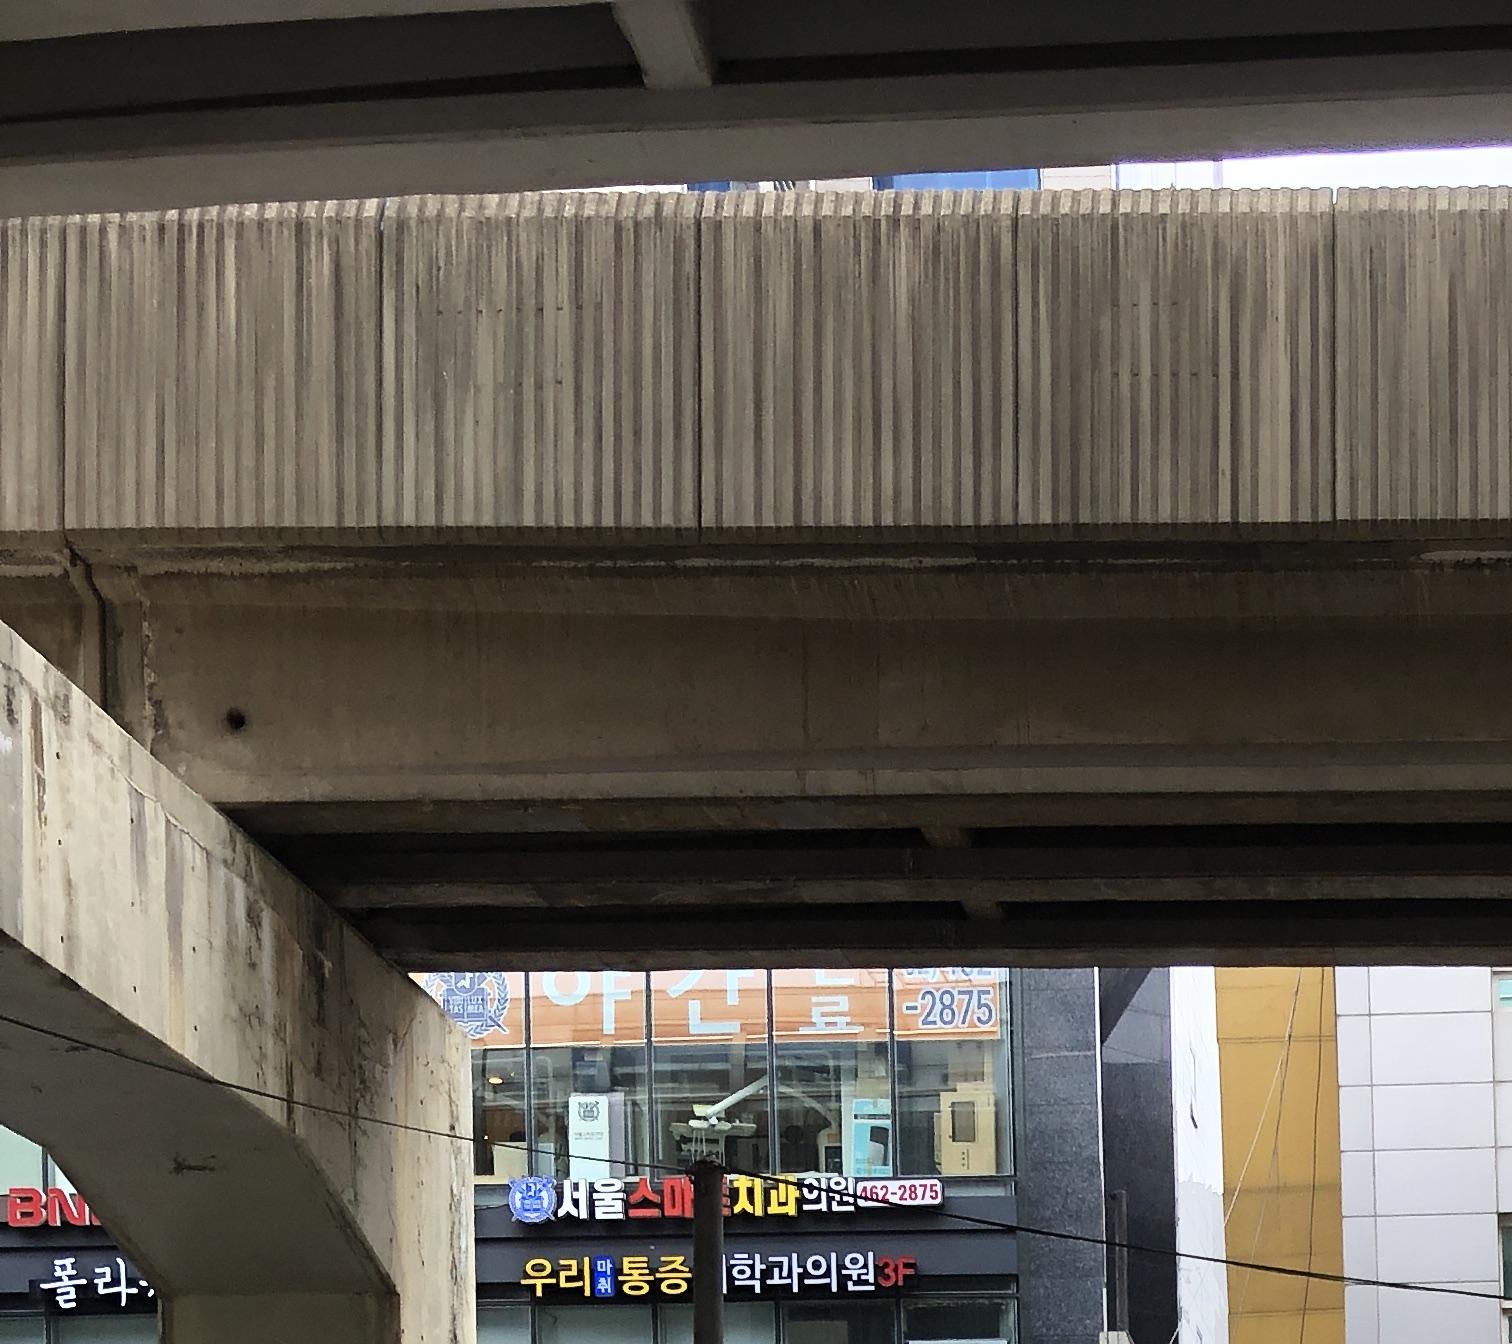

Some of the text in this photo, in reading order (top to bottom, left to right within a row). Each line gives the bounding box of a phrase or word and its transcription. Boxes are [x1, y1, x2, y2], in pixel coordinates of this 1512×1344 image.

[905, 988, 994, 1027] -2875
[8, 1187, 102, 1227] BN
[557, 1177, 941, 1220] 서울스마치과의원 462-2875
[39, 1257, 155, 1309] 폴라
[878, 1255, 918, 1287] 3F
